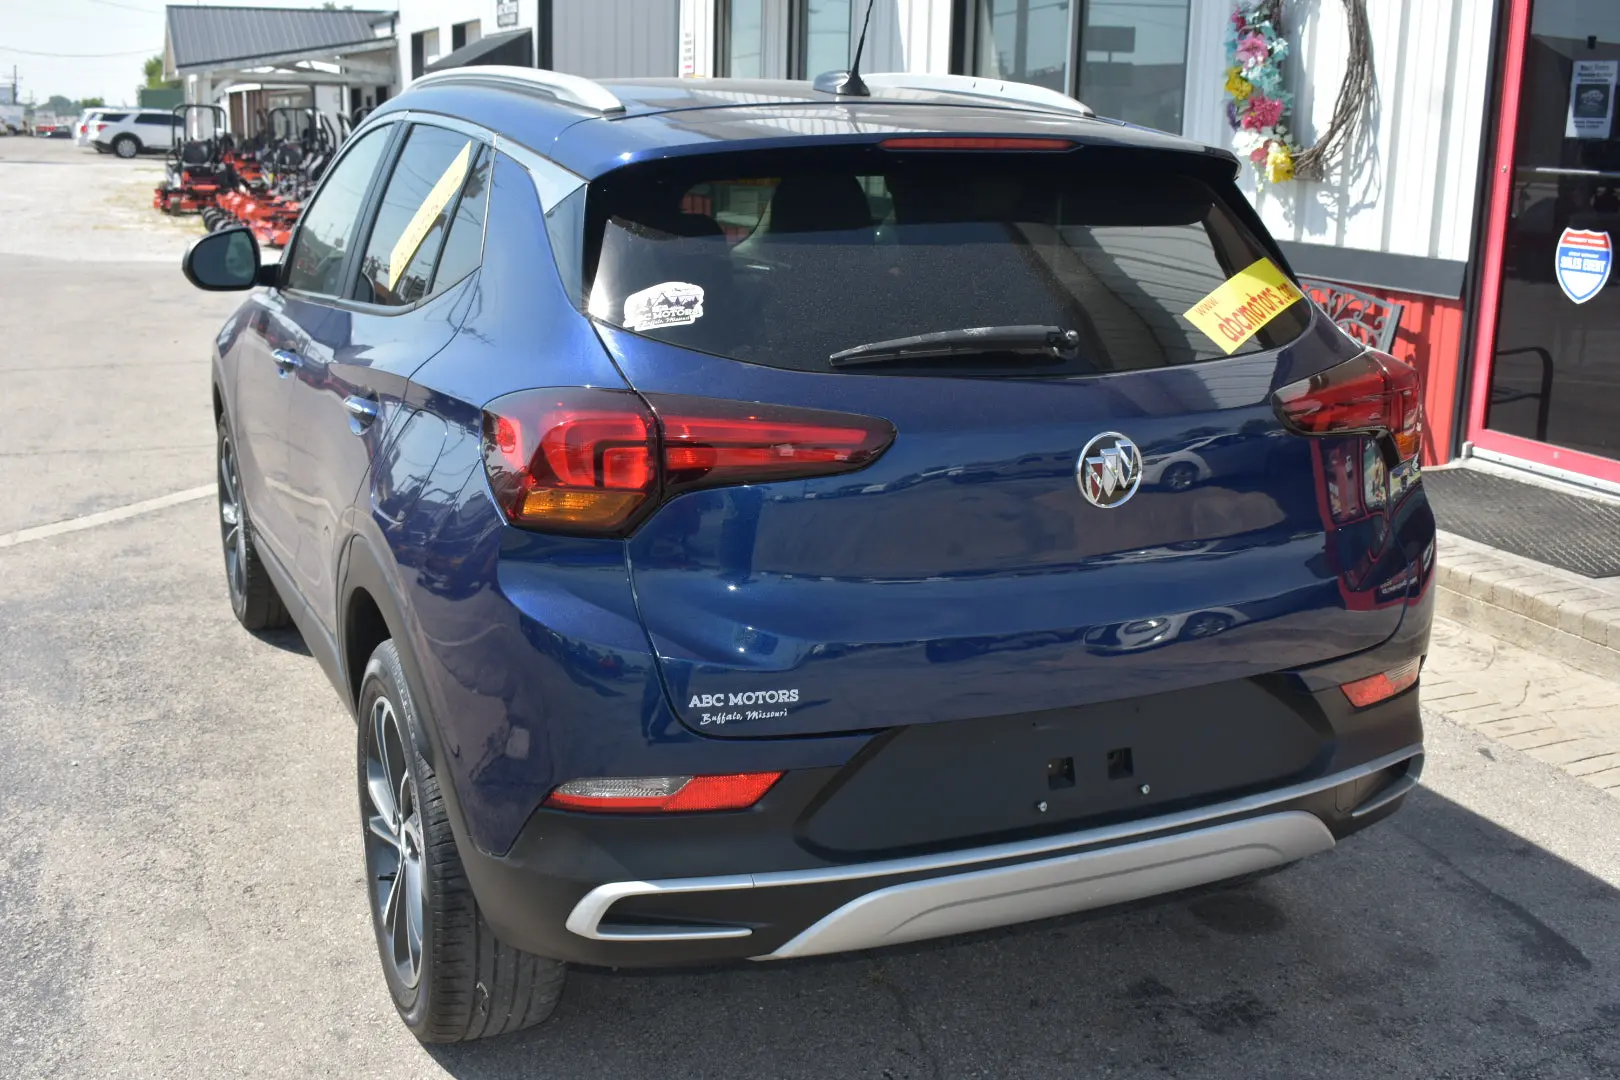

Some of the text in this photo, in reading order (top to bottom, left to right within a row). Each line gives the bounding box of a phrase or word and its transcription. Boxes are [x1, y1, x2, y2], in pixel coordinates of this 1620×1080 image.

[688, 689, 799, 707] ABC MOTORS
[700, 708, 788, 725] Buffalo, Missouri
